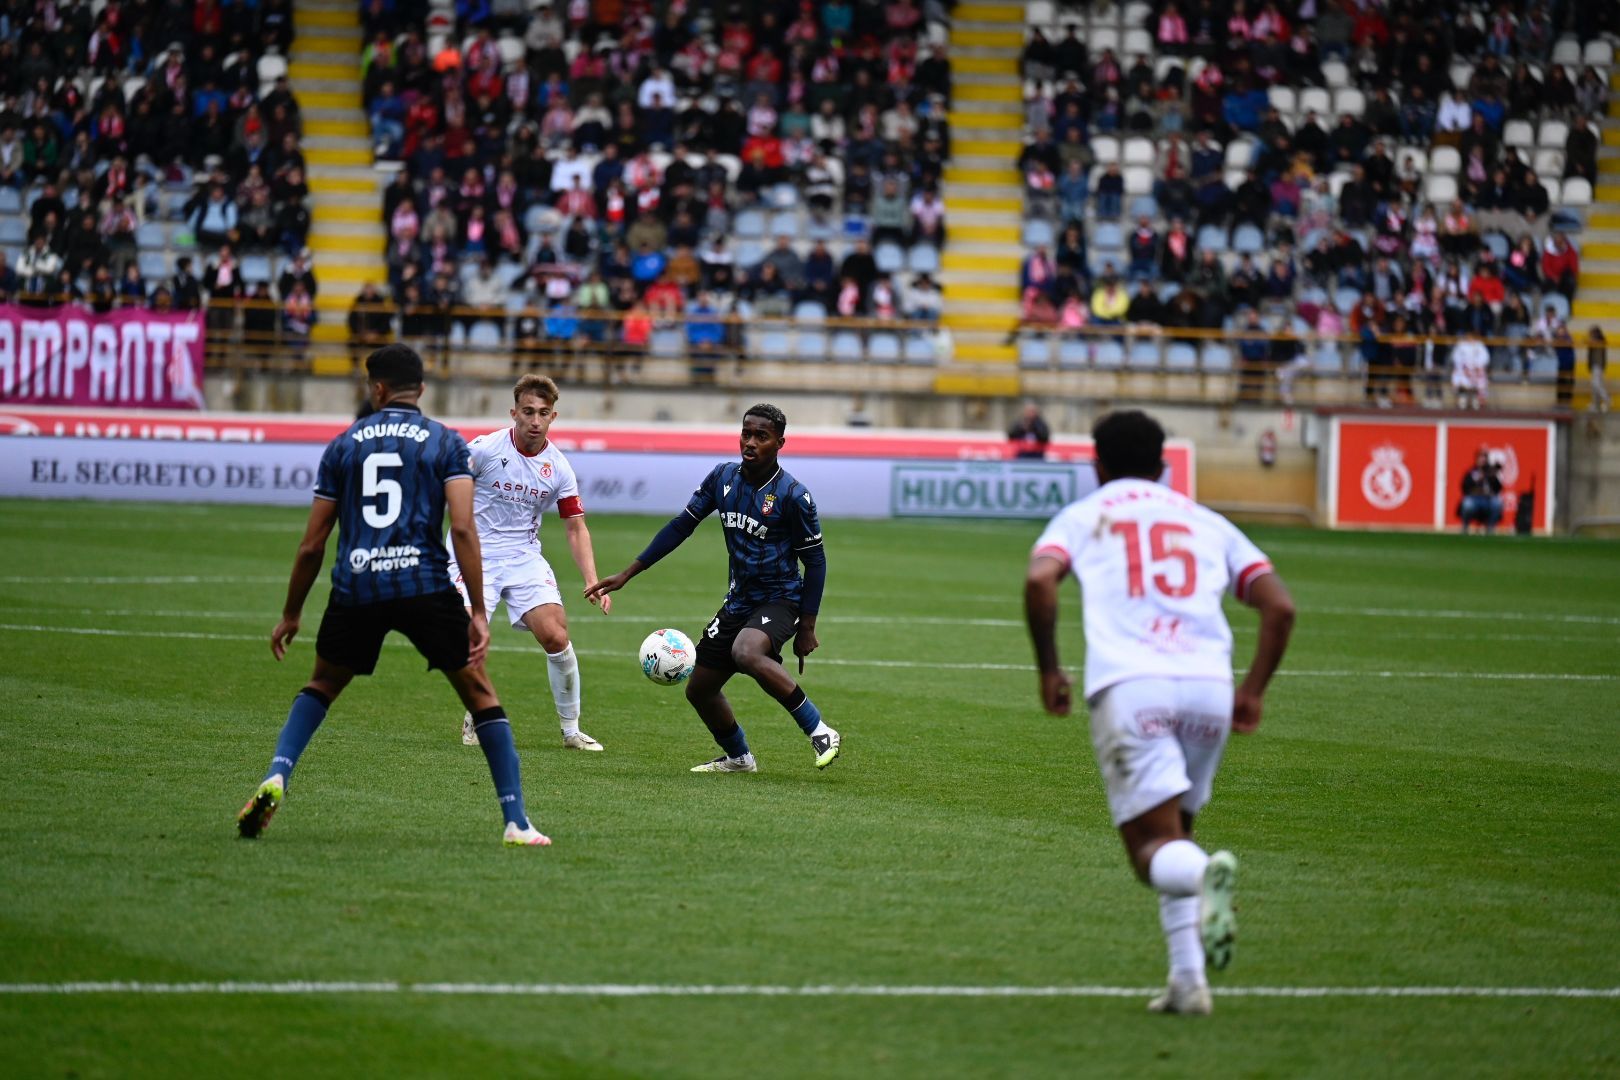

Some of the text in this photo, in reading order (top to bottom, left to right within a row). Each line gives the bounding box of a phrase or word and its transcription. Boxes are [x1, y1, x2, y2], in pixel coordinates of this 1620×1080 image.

[352, 423, 430, 442] YOUNESS
[31, 460, 67, 483] EL
[75, 461, 216, 488] SECRETO
[224, 465, 265, 488] DE
[362, 452, 403, 528] 5
[491, 480, 549, 499] ASPIRE
[902, 478, 1065, 508] HIJOLUSA
[371, 557, 419, 572] MOTOR
[1111, 520, 1197, 599] 15
